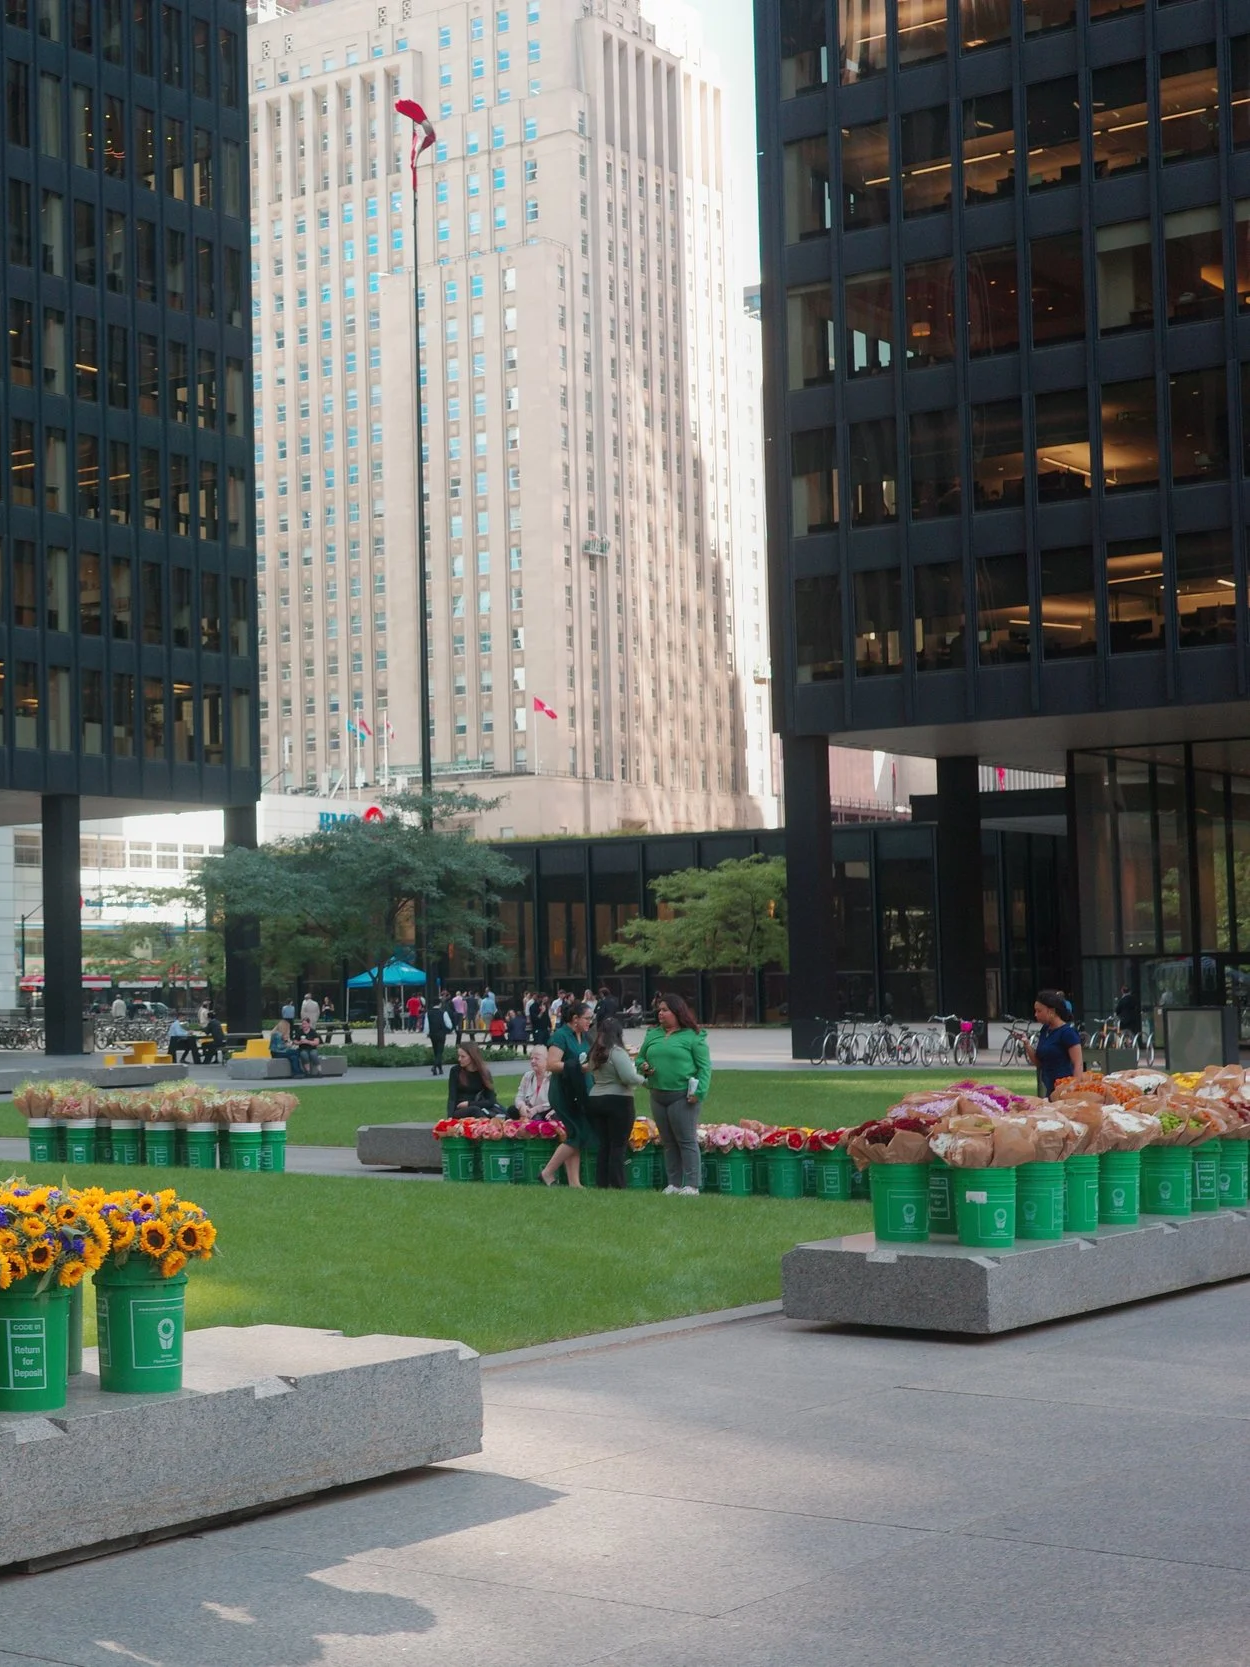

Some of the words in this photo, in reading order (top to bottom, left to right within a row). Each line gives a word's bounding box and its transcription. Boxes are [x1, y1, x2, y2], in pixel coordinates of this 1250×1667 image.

[13, 1323, 33, 1331] CODE
[14, 1345, 40, 1354] Return
[22, 1356, 34, 1366] for
[14, 1368, 43, 1378] Deposit
